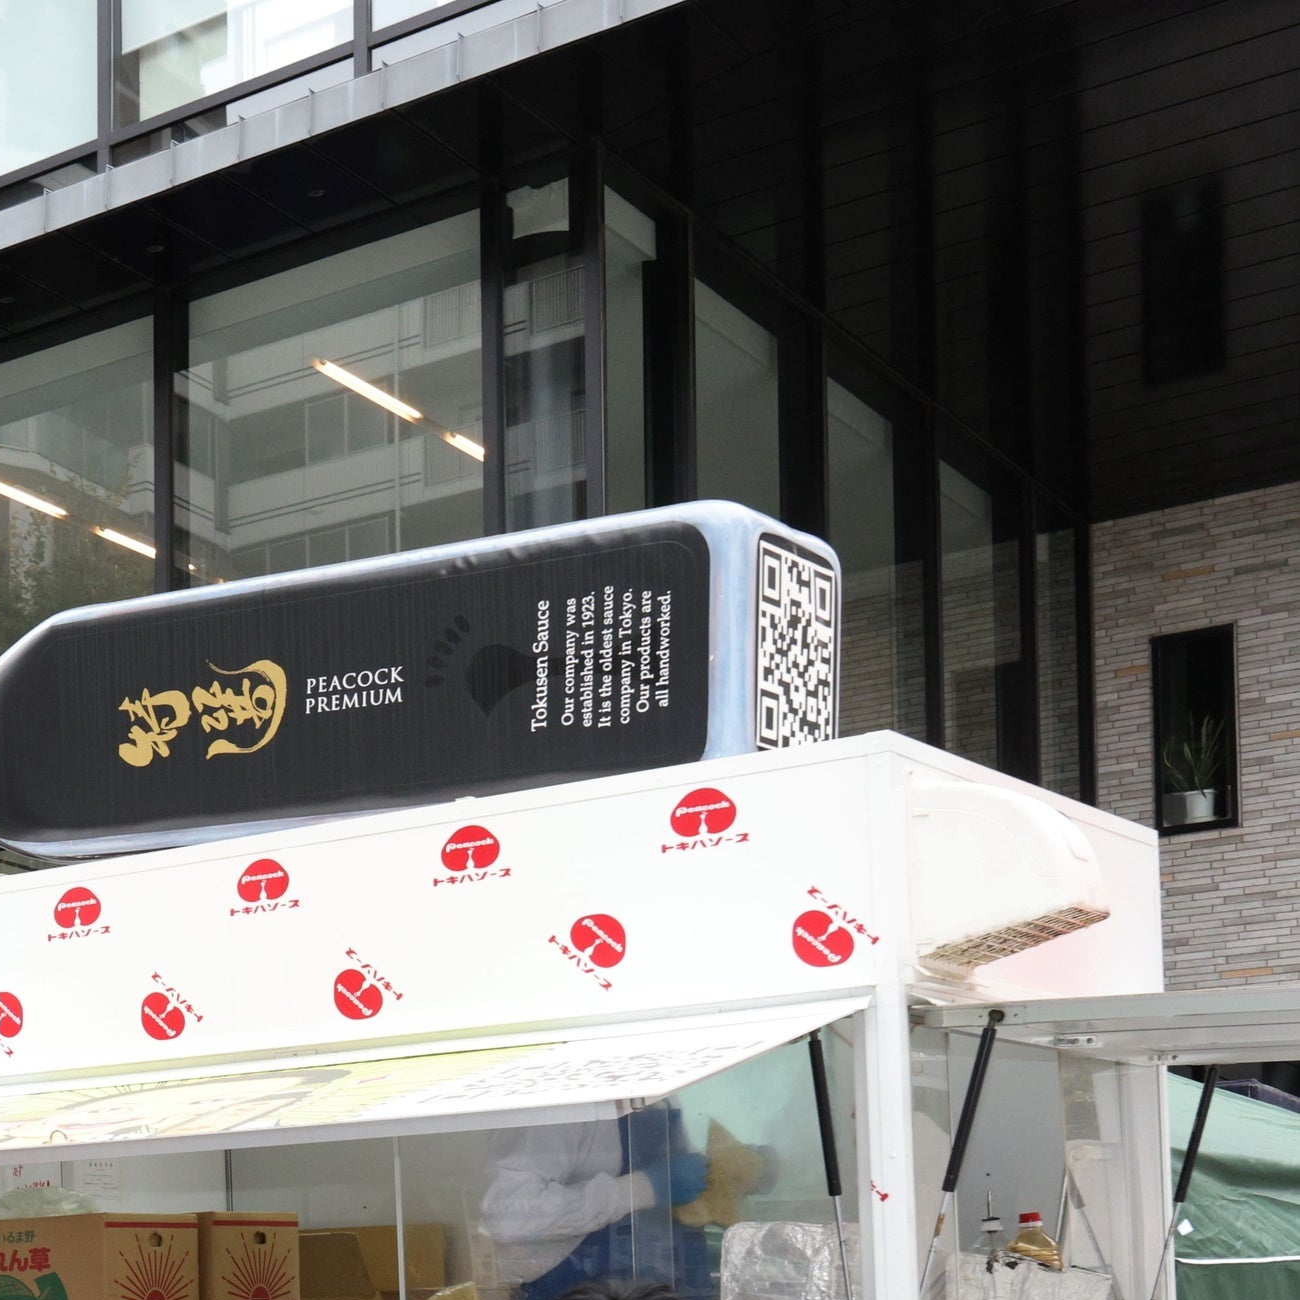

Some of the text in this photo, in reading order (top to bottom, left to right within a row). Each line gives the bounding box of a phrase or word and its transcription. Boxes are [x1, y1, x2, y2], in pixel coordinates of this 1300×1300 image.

[305, 687, 403, 714] PREMIUM
[306, 666, 404, 694] PEACOCK
[531, 600, 550, 732] Tokusen Sauce
[561, 597, 579, 726] Our company was
[580, 591, 595, 727] established in 1923.
[598, 585, 614, 728] It is the oldest sauce
[619, 588, 636, 724] company in Tokyo.
[636, 590, 654, 712] Our products are
[655, 590, 671, 707] all handworked.
